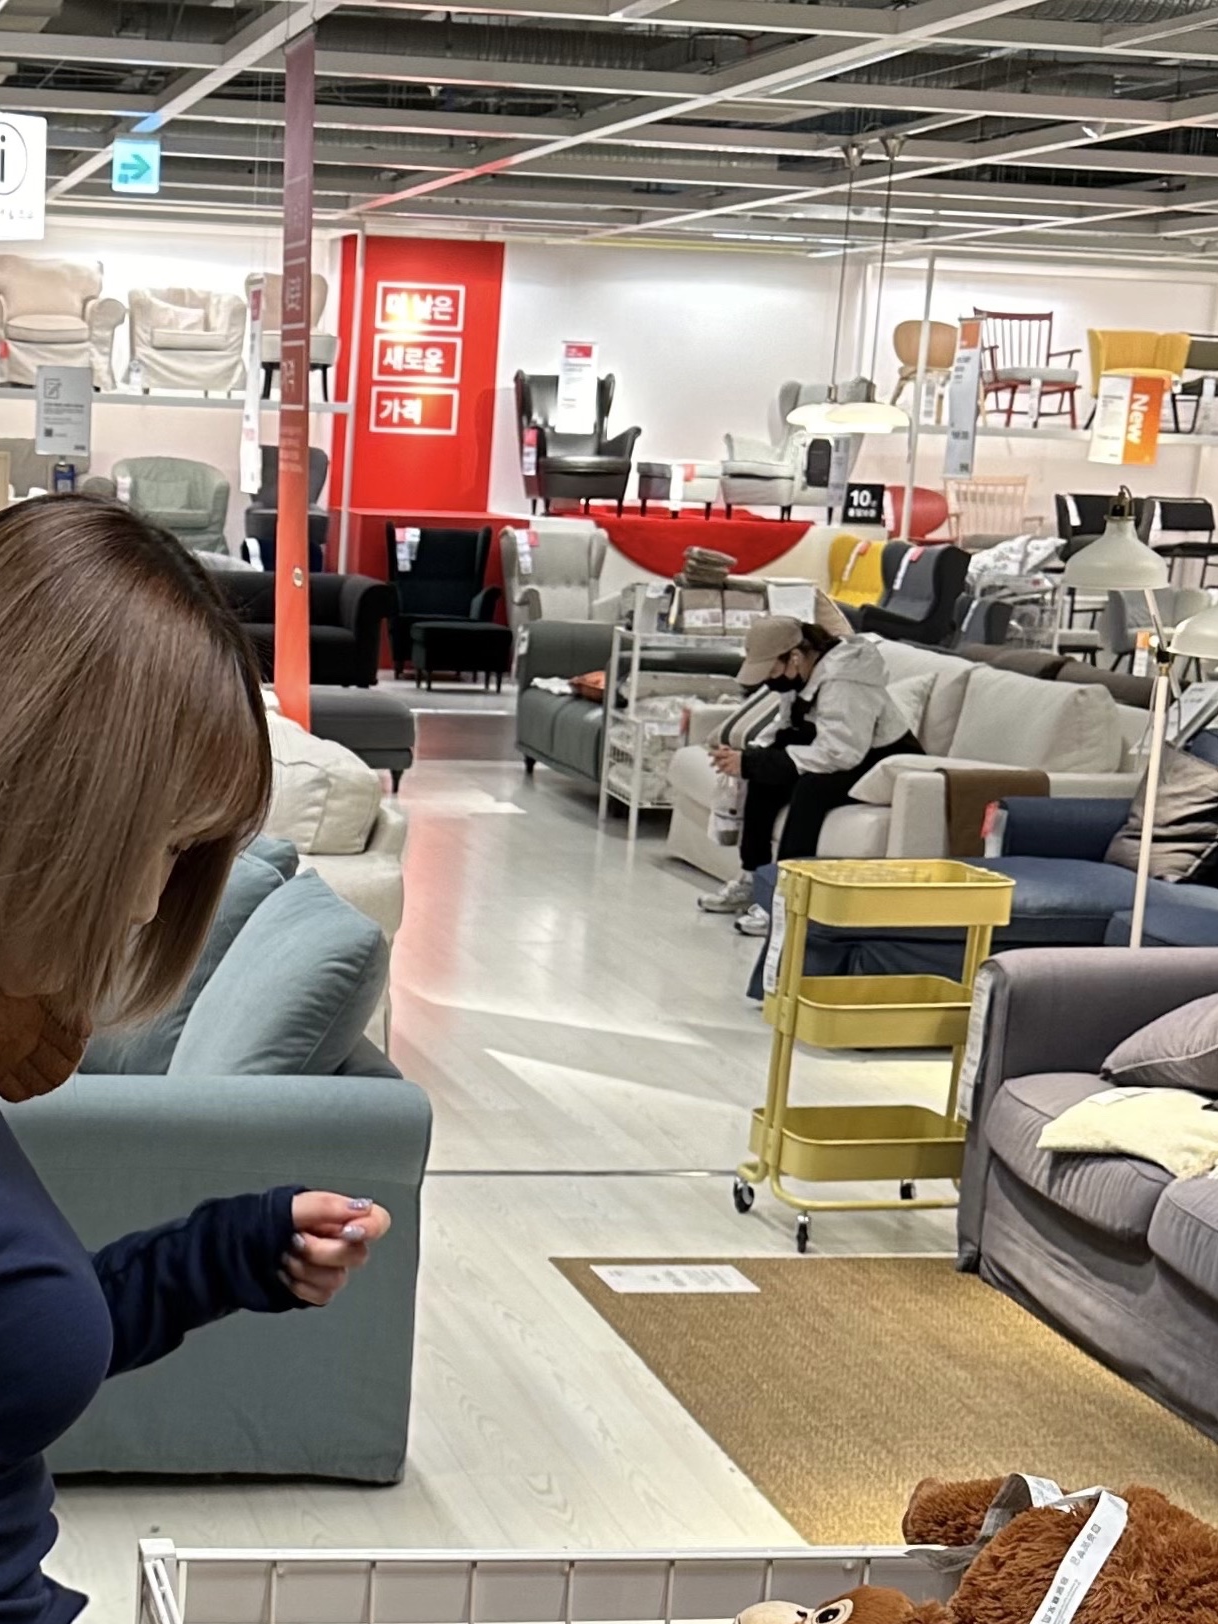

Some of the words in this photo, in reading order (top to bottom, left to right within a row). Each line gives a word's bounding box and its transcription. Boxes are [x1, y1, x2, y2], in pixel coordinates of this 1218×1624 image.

[383, 345, 444, 374] 새로운
[379, 398, 422, 425] 가격
[1126, 393, 1150, 445] New
